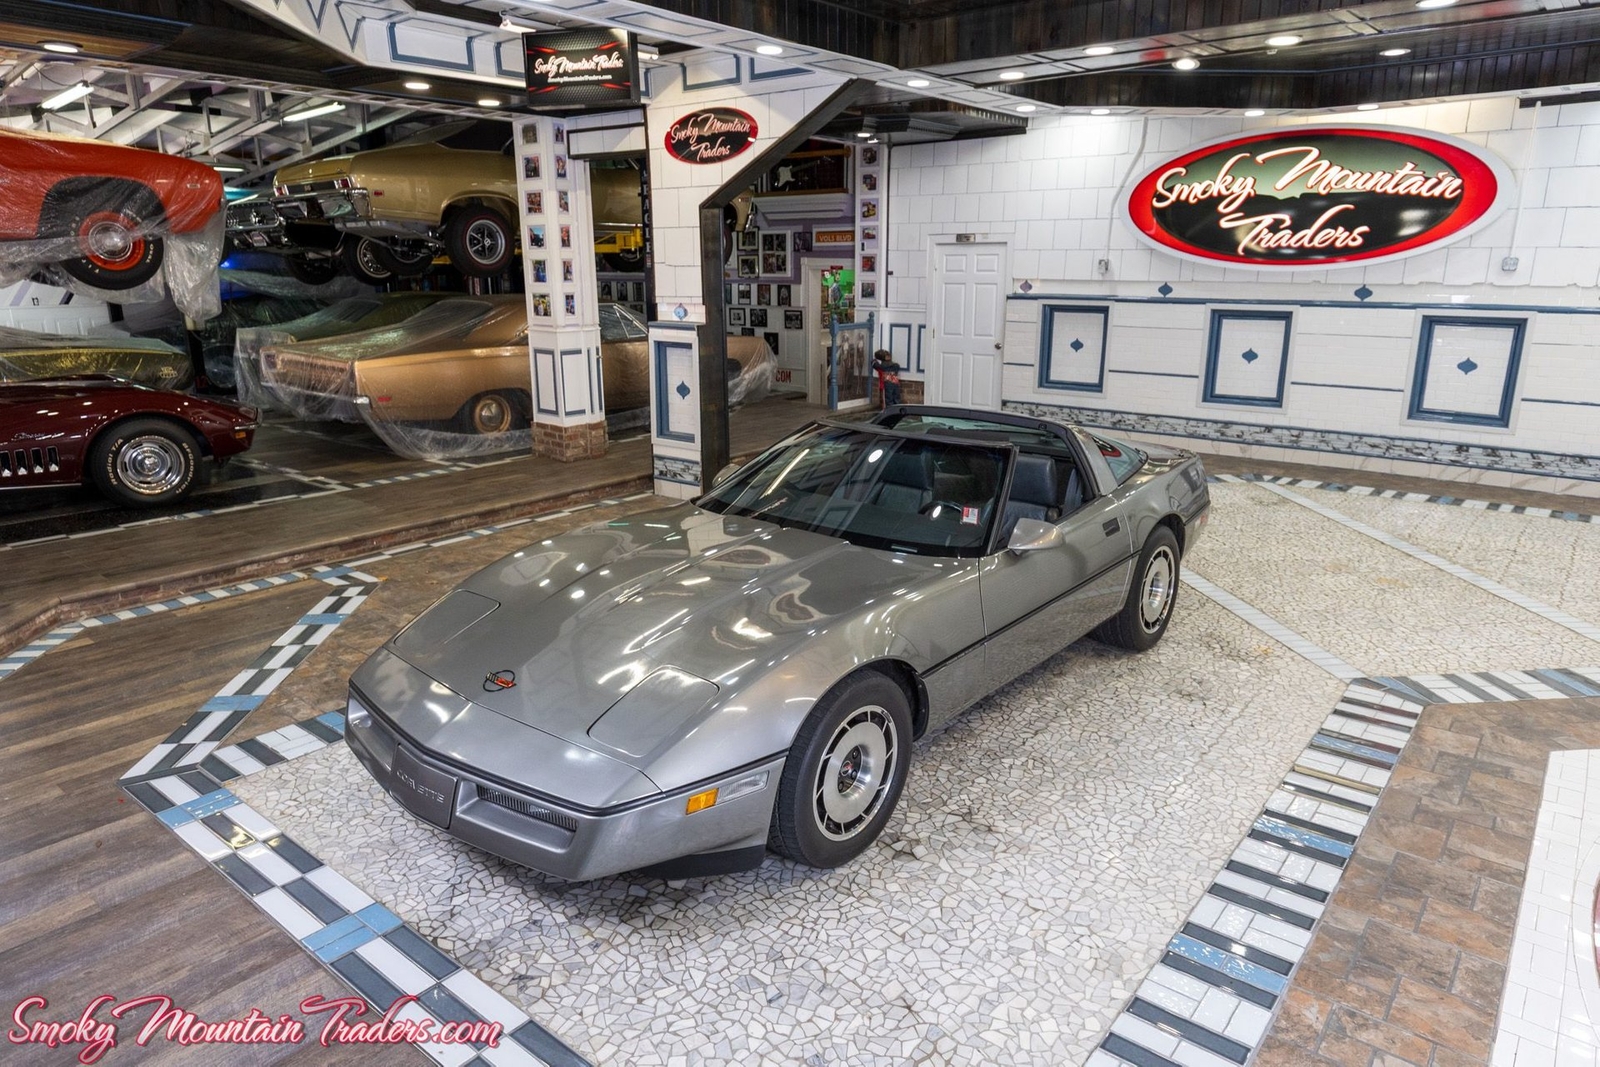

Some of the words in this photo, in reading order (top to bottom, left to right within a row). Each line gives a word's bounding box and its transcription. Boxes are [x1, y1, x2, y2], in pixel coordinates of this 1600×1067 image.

[534, 56, 558, 77] Smoky
[555, 56, 597, 73] Mountain
[593, 51, 624, 71] Traders
[671, 117, 699, 143] Smoky
[698, 113, 750, 134] Mountain
[691, 137, 730, 162] Traders
[1151, 152, 1257, 214] Smoky
[1255, 146, 1464, 200] Mountain
[819, 234, 835, 242] VOLS
[1219, 203, 1371, 256] Traders
[396, 769, 445, 803] CORVETTE
